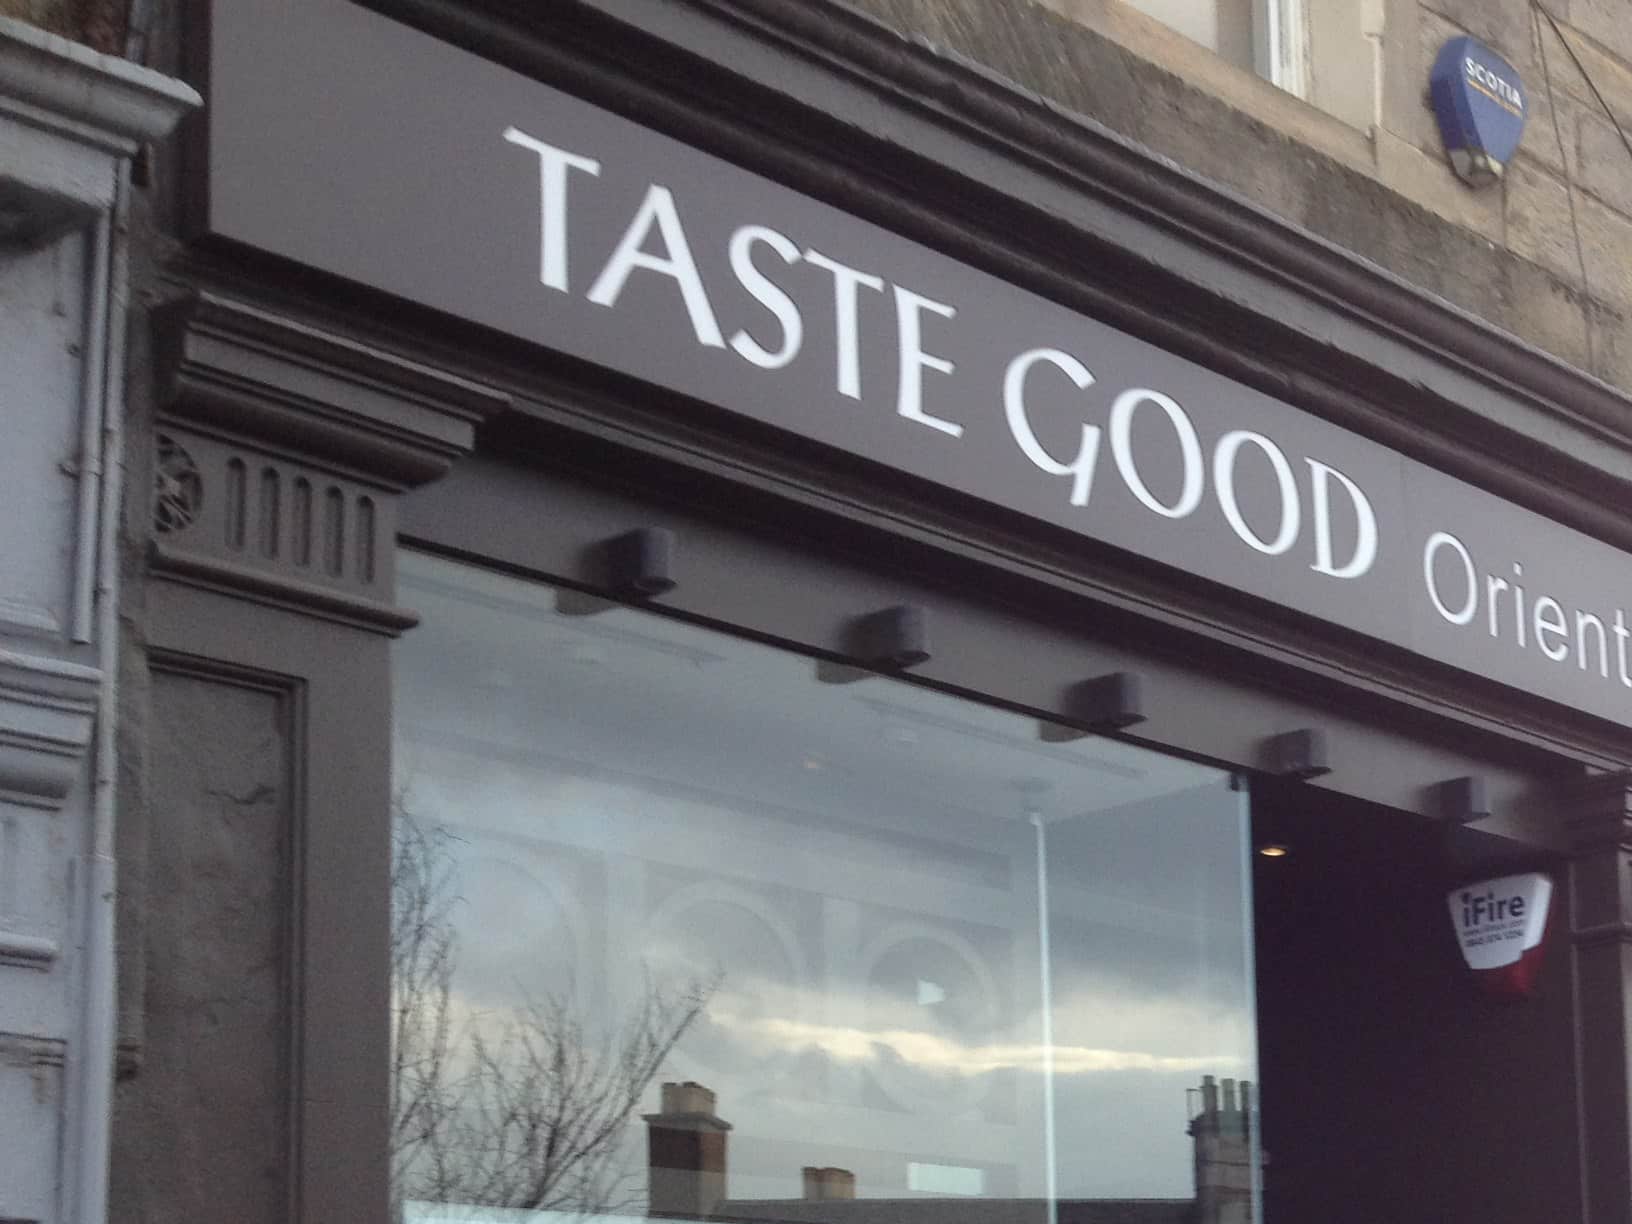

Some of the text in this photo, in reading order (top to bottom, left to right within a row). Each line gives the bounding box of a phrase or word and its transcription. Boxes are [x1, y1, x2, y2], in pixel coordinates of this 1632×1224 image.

[1464, 56, 1523, 110] SCOTIA
[503, 126, 964, 440] TASTE
[1002, 346, 1379, 579] GOOD
[1461, 891, 1526, 928] iFire
